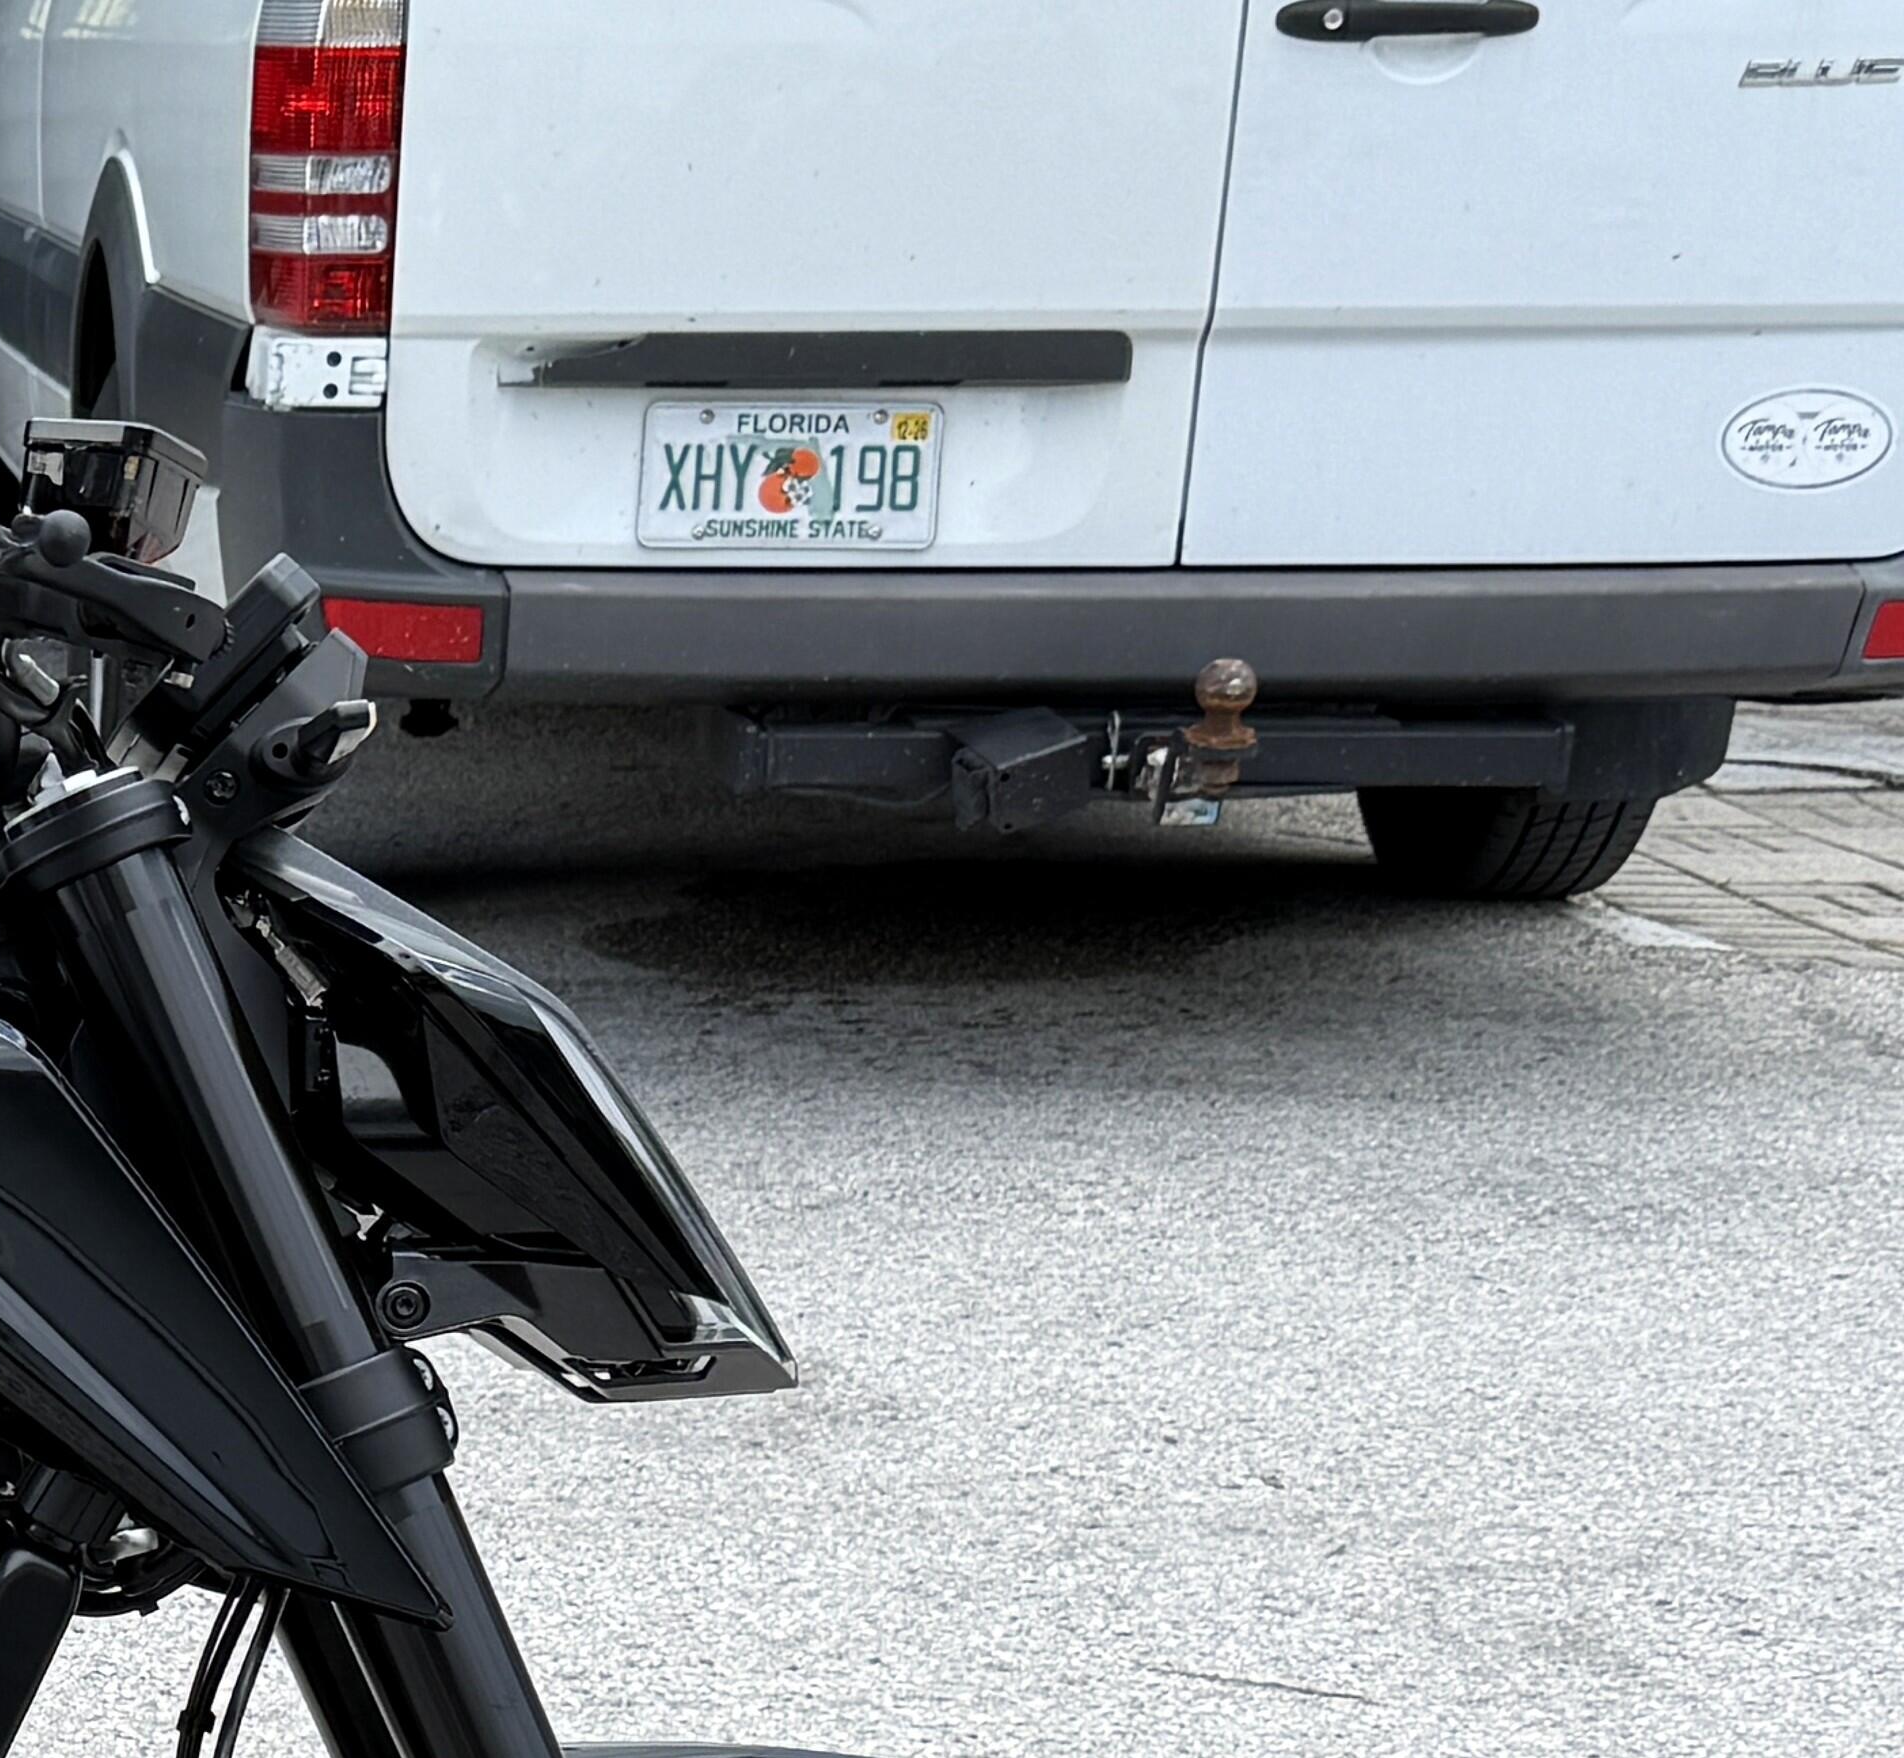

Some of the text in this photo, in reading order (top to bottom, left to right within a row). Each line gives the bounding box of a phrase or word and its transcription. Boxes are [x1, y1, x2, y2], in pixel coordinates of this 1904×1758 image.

[737, 413, 850, 435] FLORIDA
[658, 443, 922, 511] XHY 198
[704, 518, 869, 540] SUNSHINE STATE
